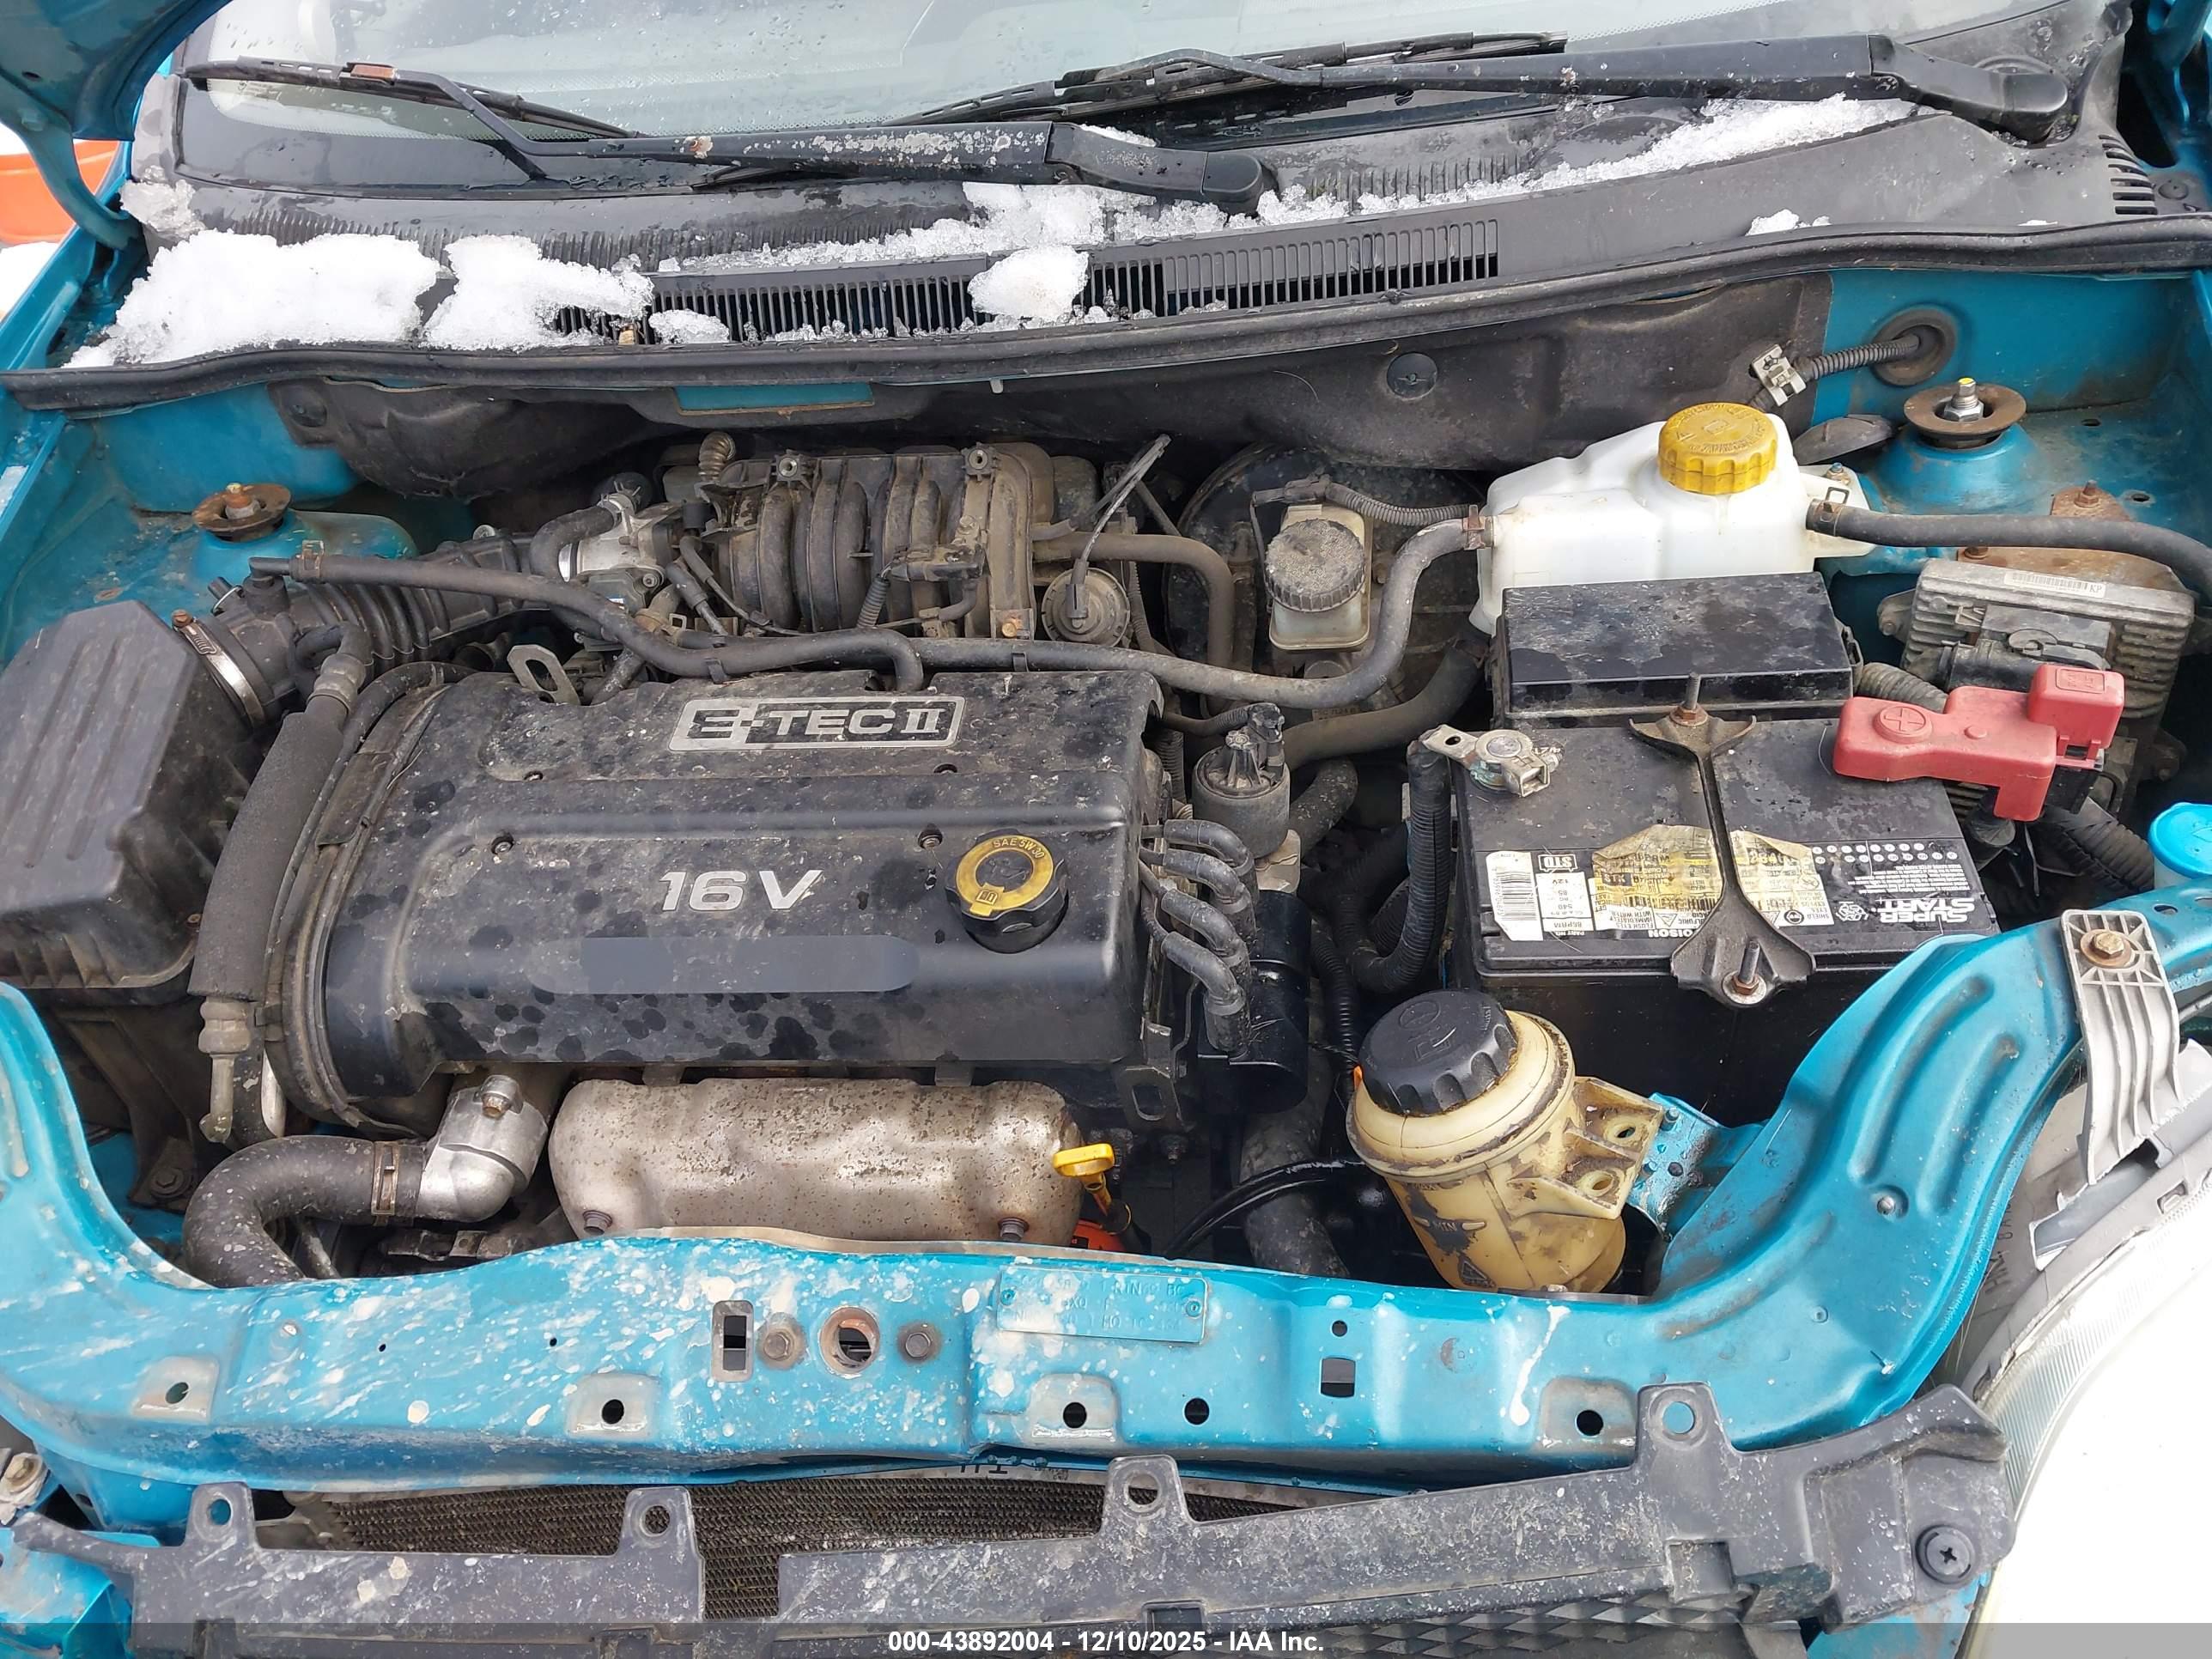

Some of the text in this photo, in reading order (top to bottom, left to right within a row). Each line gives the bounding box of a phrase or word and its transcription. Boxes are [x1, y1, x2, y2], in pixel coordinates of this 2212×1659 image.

[2089, 583, 2102, 593] KP
[686, 708, 945, 739] E-TEC II
[993, 837, 1018, 848] SAE
[1877, 898, 1975, 912] START
[1881, 911, 1968, 923] SUPER
[1648, 929, 1693, 938] OISON
[1432, 1222, 1457, 1231] MIN
